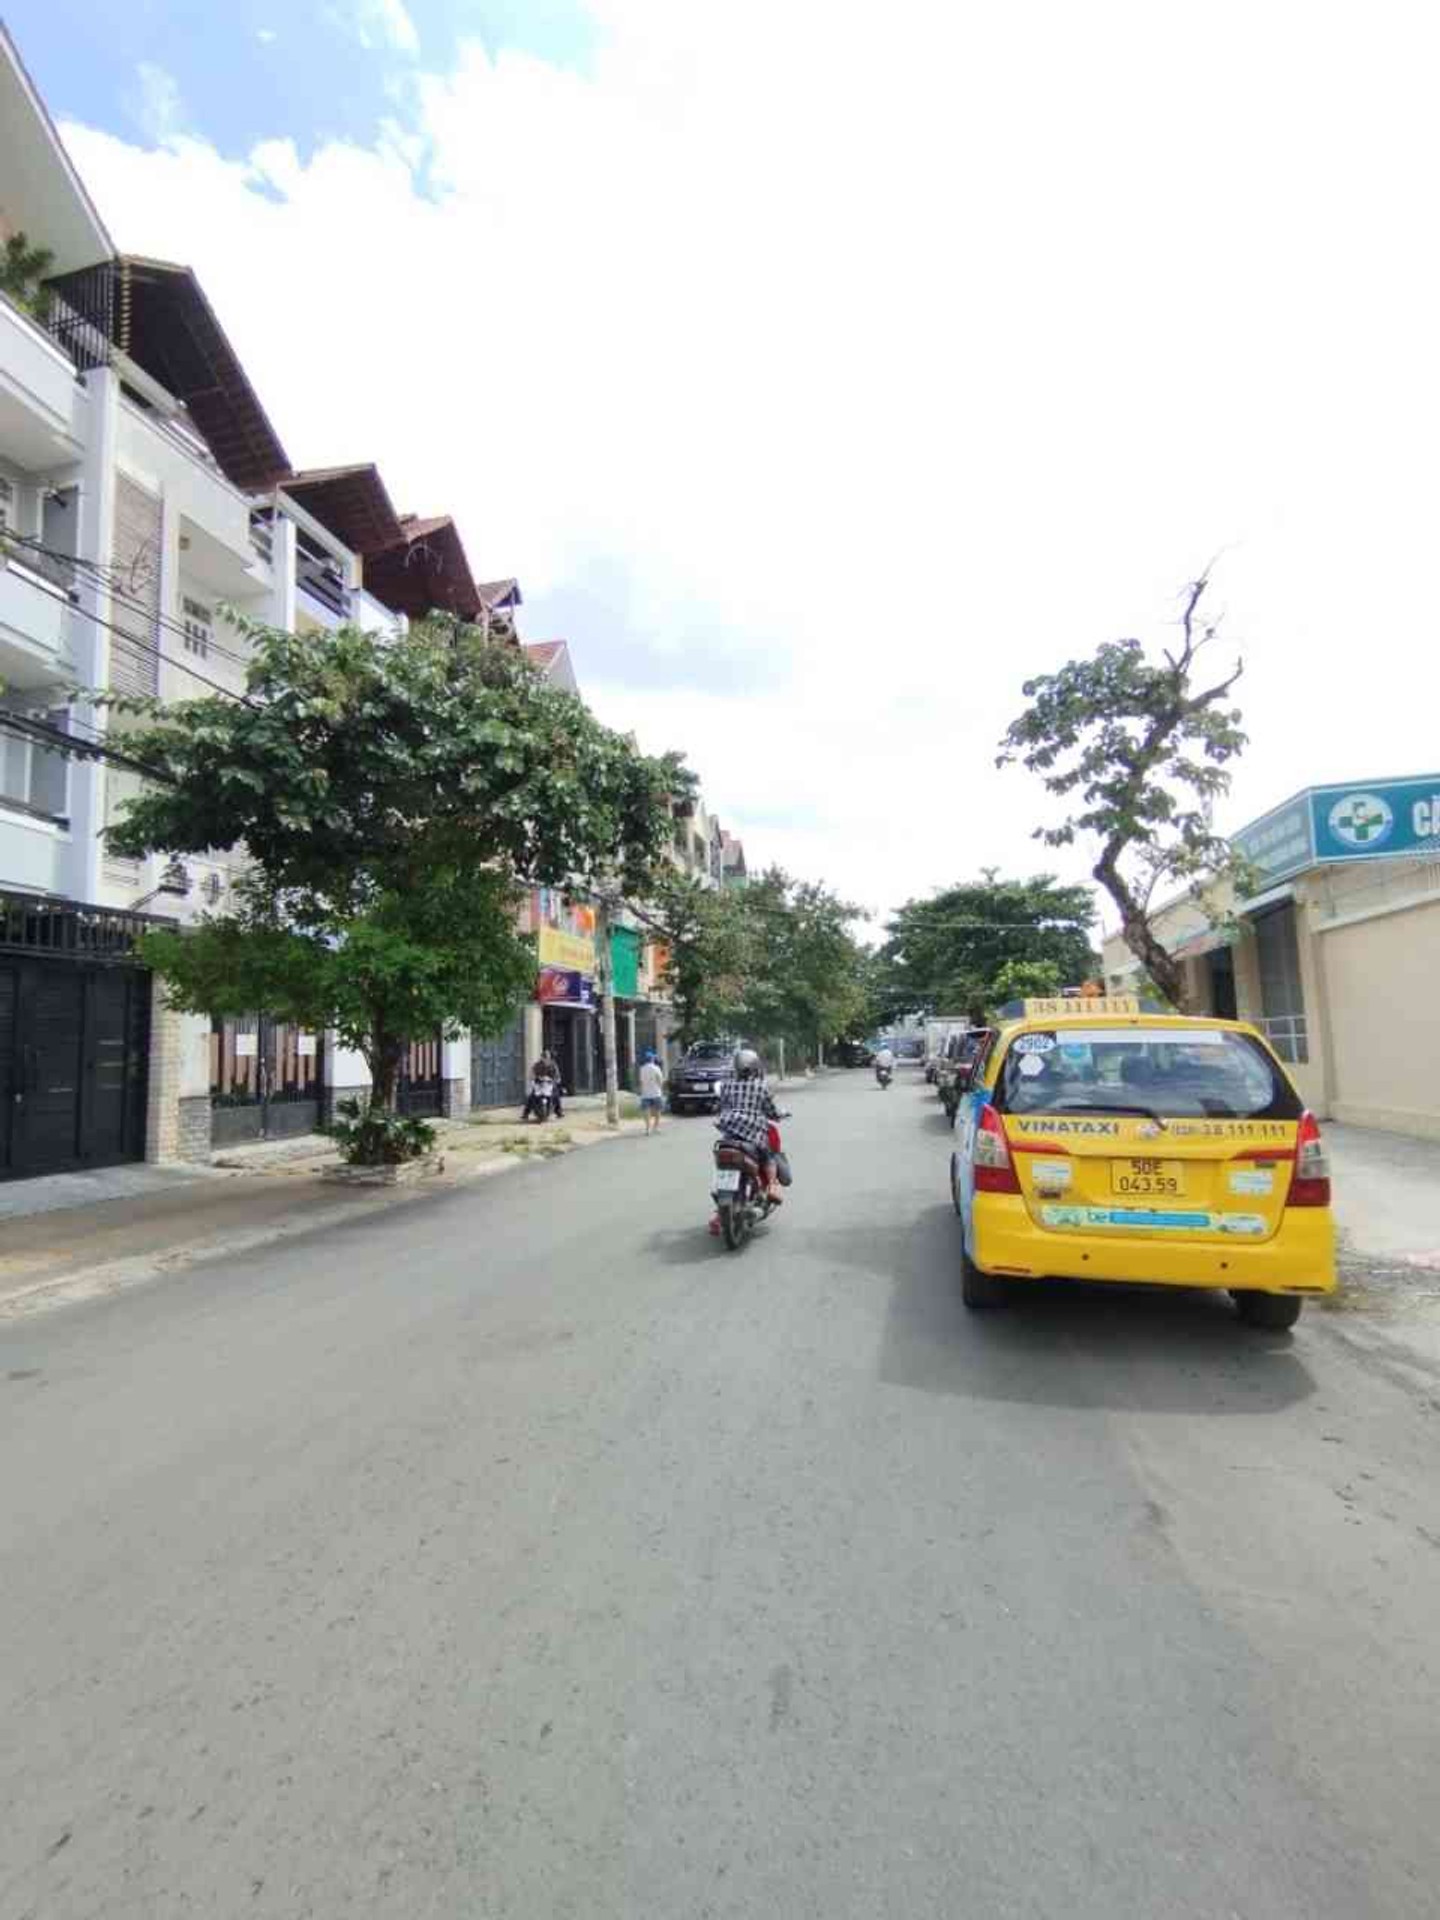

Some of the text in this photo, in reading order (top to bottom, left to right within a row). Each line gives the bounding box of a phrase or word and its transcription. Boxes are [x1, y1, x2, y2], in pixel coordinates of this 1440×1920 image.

[1018, 1119, 1119, 1135] VINATAXI
[1228, 1124, 1254, 1137] 111
[1262, 1124, 1286, 1137] 111
[1119, 1176, 1177, 1191] 043.59
